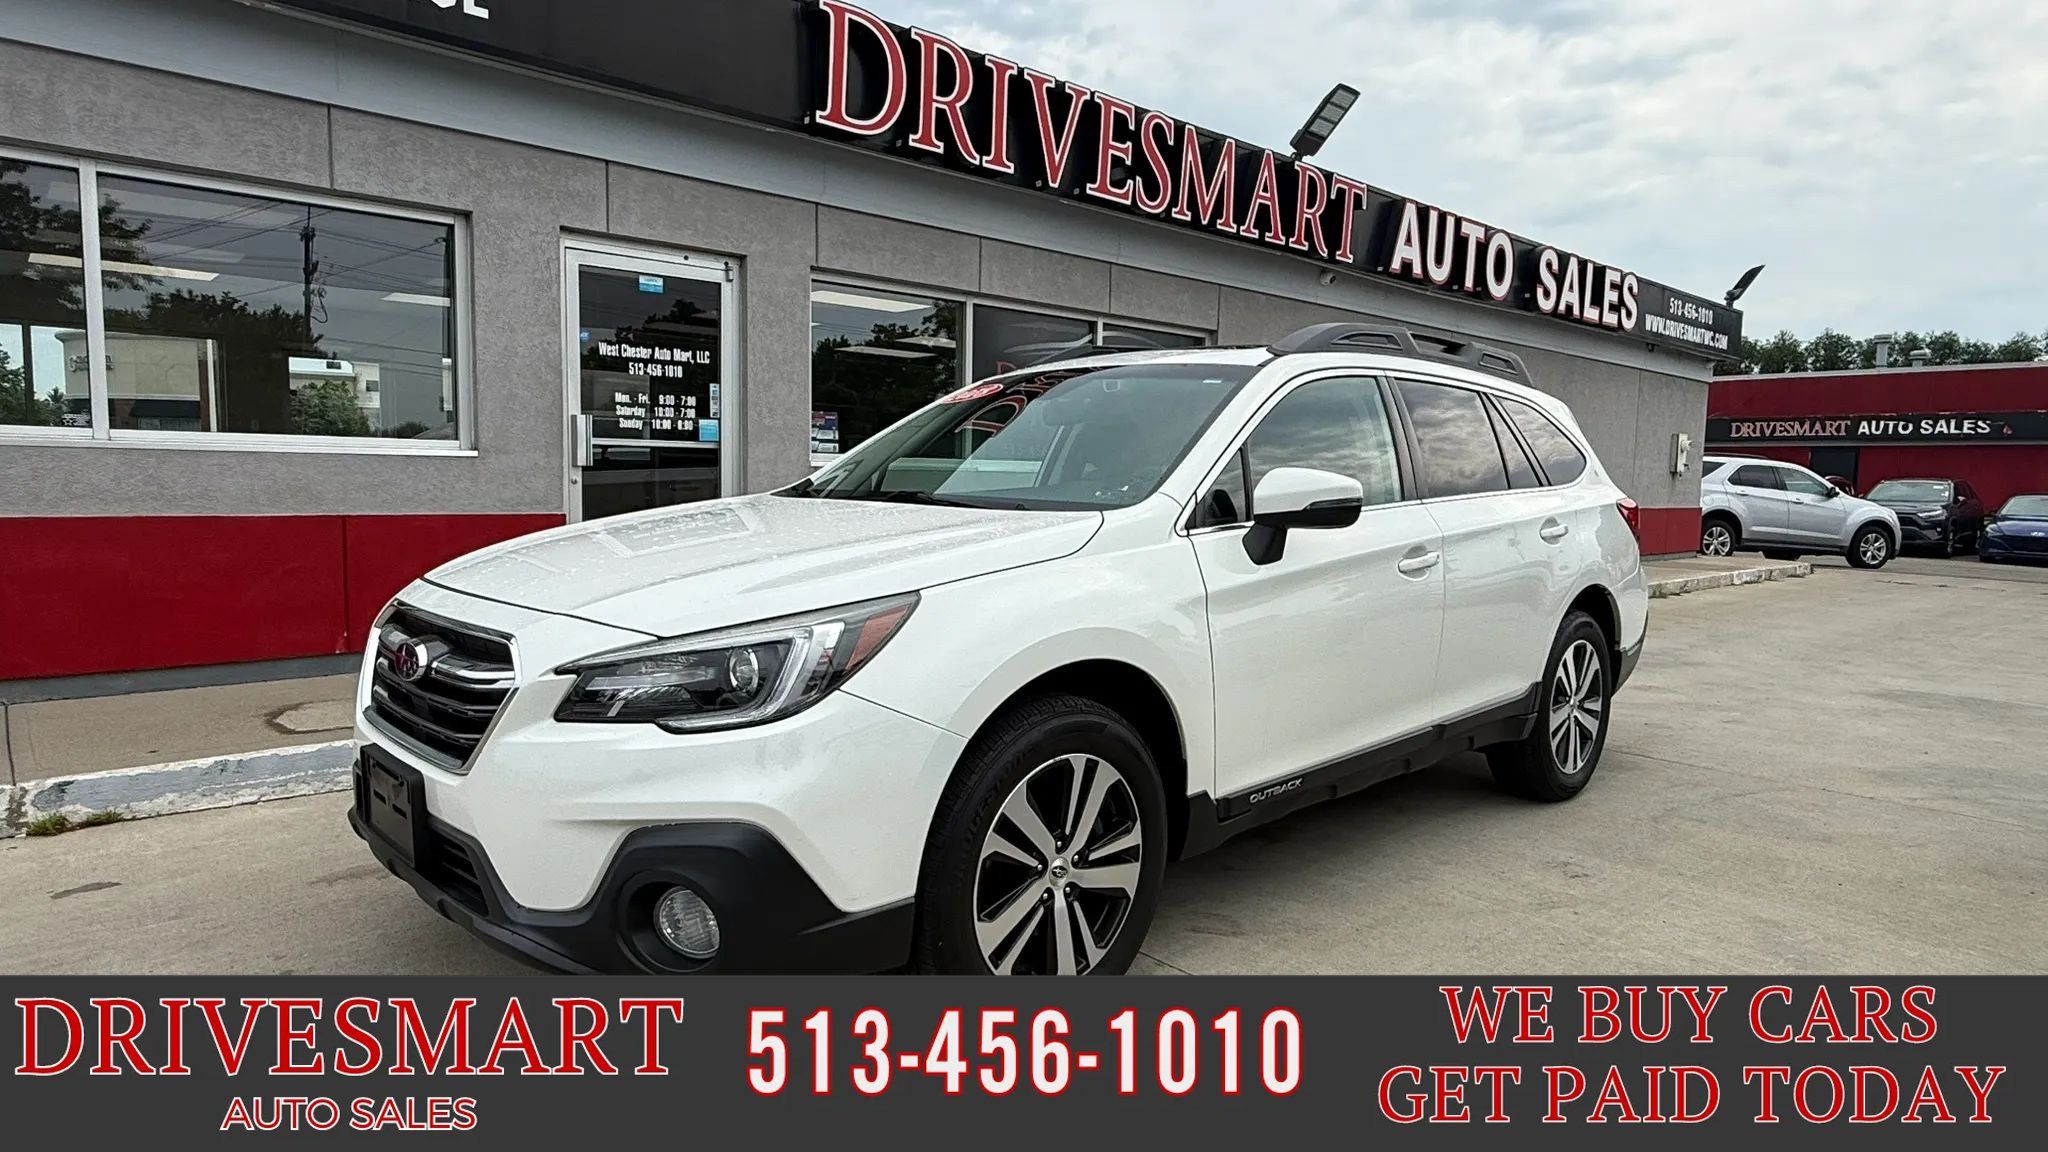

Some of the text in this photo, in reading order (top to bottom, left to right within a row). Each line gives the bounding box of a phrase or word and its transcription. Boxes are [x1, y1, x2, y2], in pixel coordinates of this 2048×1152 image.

[816, 0, 1640, 333] DRIVESMART AUTO SALES
[1669, 297, 1714, 325] 513-456-1010
[1645, 313, 1729, 350] WWW.DRIVESMARTWC.COM
[598, 341, 710, 365] West Chester Auto Mart, LLC
[628, 362, 683, 378] 513-456-1010
[615, 392, 632, 403] Mon.
[638, 393, 651, 404] Fri.
[658, 394, 675, 406] 9:00
[680, 395, 696, 407] 7:00
[615, 405, 646, 418] Saturday
[654, 407, 675, 418] 10:00
[680, 408, 696, 419] 7:00
[619, 418, 643, 430] Sunday
[651, 419, 672, 430] 10:00
[1730, 419, 1991, 438] DRIVESMART AUTO SALES
[1249, 778, 1303, 803] OUTBACK
